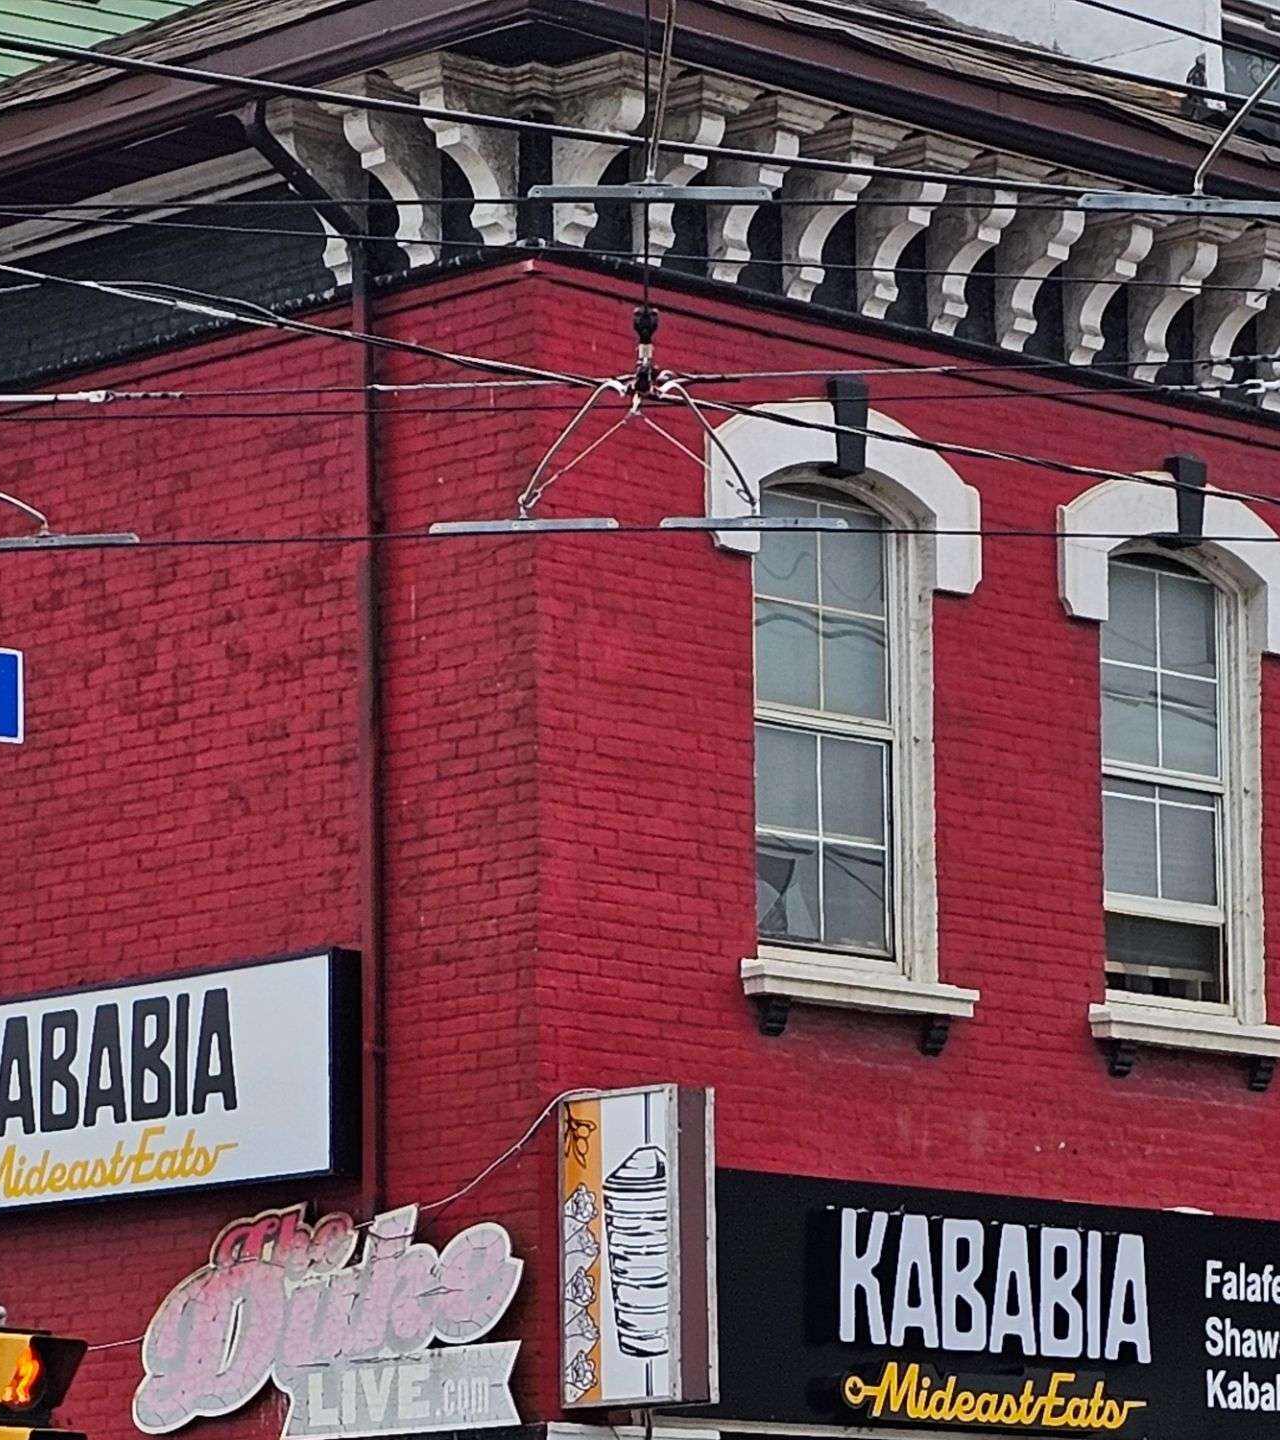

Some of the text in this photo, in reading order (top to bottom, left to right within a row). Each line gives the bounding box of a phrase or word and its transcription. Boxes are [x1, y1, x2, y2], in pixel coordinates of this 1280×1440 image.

[219, 1207, 354, 1270] The
[839, 1207, 1152, 1364] KABABIA
[140, 1212, 515, 1425] Duke
